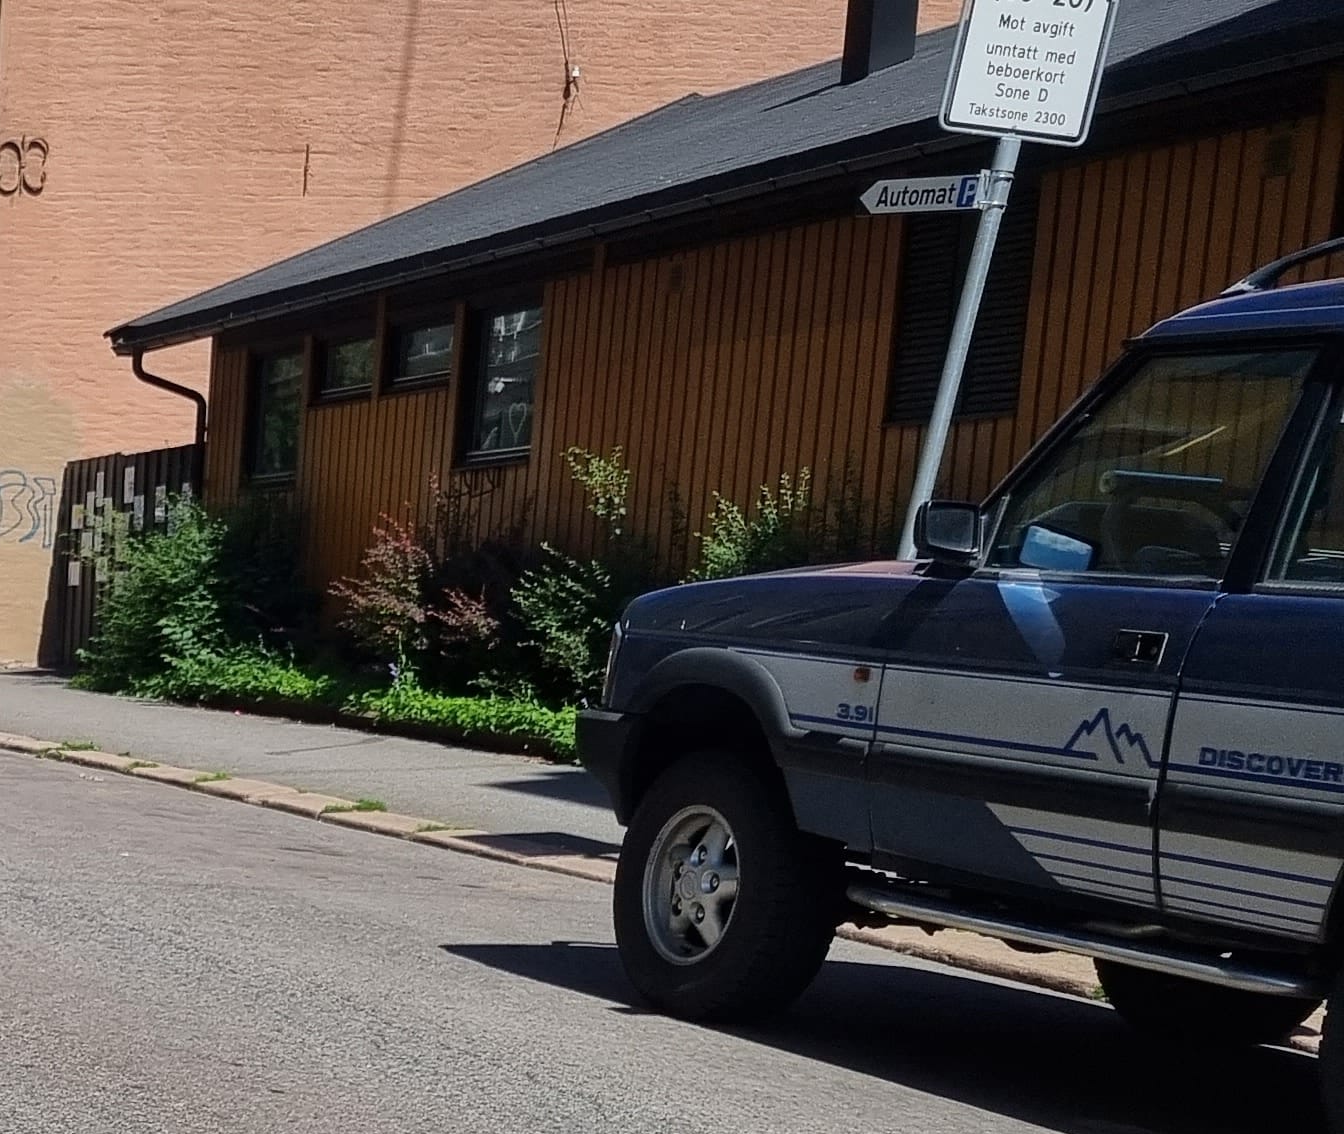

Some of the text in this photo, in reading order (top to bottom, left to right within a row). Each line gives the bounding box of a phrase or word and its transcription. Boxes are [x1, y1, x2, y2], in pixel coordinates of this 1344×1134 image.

[999, 14, 1075, 38] Mot avgift
[986, 43, 1076, 65] unntatt med
[987, 61, 1065, 84] beboerkort
[995, 83, 1048, 102] Sone D
[969, 103, 1065, 125] Takstsone 2300
[876, 184, 956, 207] Automat
[1199, 747, 1344, 782] DISCOVER
